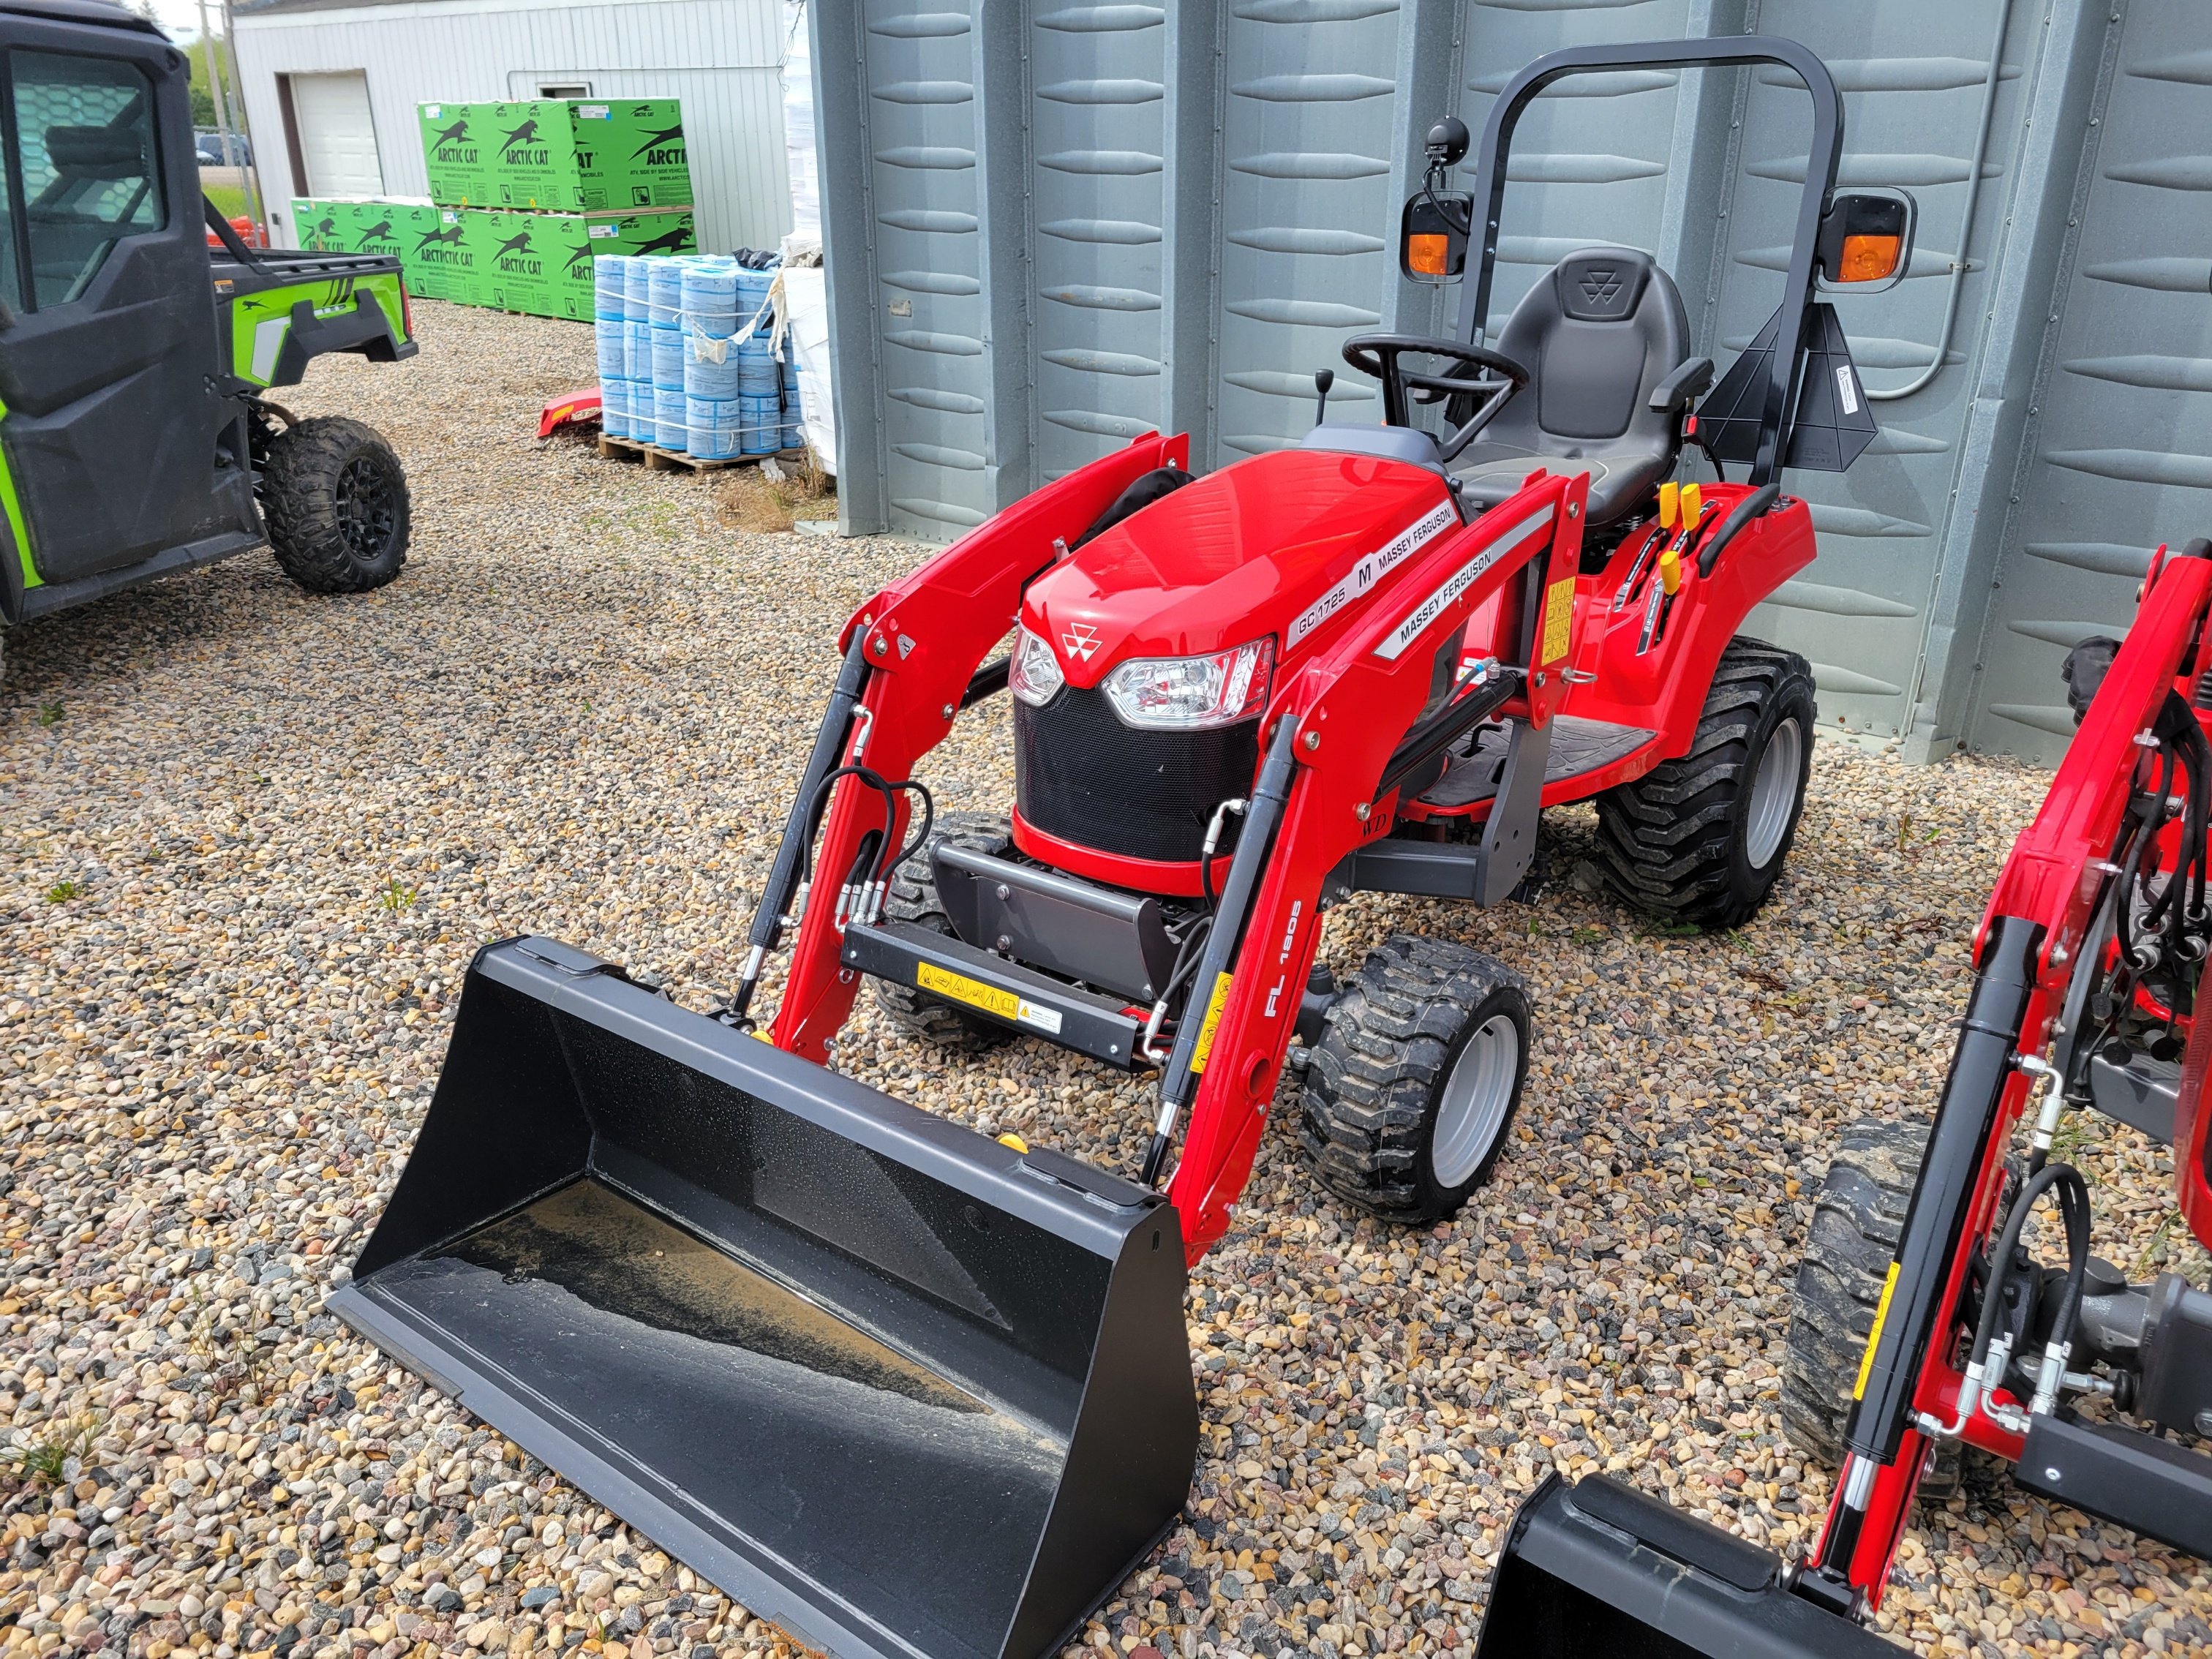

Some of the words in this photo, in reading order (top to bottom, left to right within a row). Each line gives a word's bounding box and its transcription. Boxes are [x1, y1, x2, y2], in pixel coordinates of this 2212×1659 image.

[437, 147, 463, 162] ARCTIC
[464, 148, 478, 164] CAT
[506, 150, 533, 165] ARCTIC
[534, 150, 549, 165] CAT
[460, 252, 473, 267] CAT
[500, 257, 526, 274] ARCTIC
[527, 260, 542, 276] CAT
[1299, 610, 1315, 635] GC
[1317, 587, 1345, 618] 1725
[1358, 562, 1372, 588] M
[1378, 535, 1412, 571] MASSEY
[1412, 506, 1451, 543] FERGUSON
[1400, 595, 1440, 644] MASSEY
[1443, 550, 1491, 603] FERGUSON
[1264, 974, 1285, 1017] FL
[1280, 900, 1302, 965] 1805
